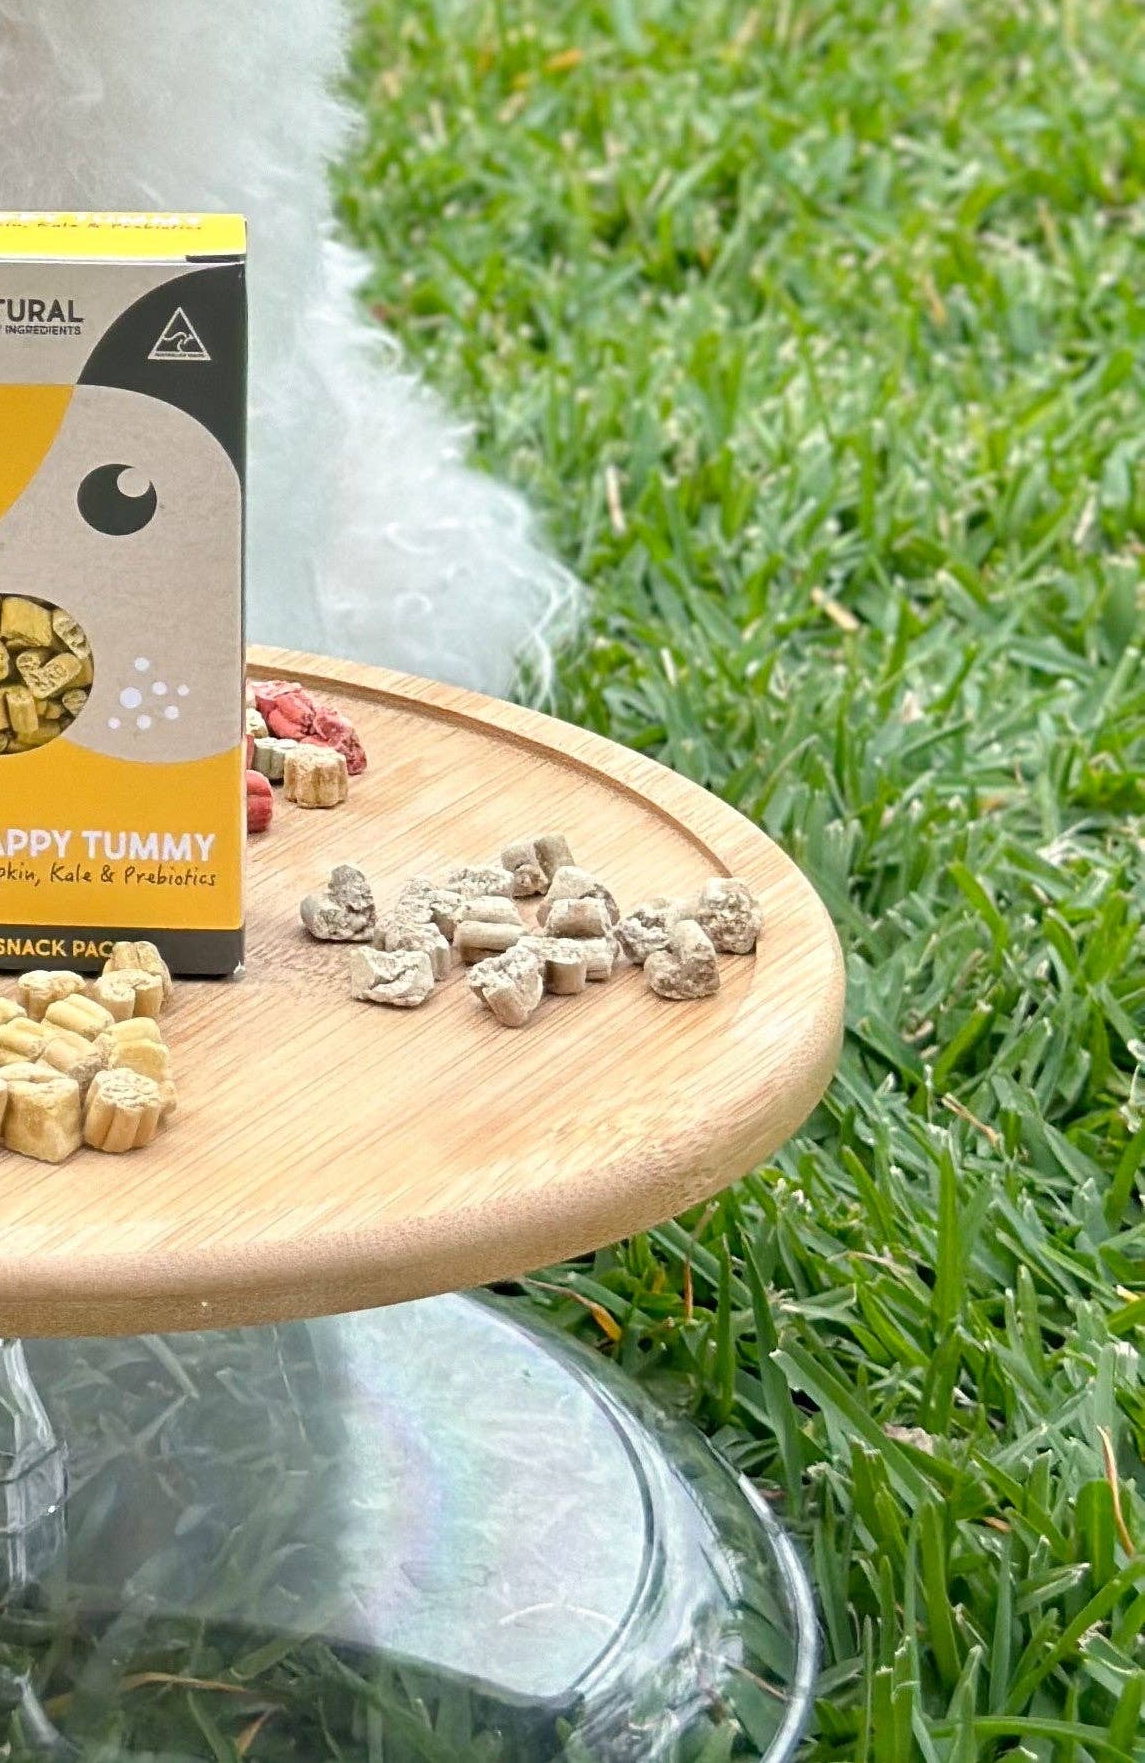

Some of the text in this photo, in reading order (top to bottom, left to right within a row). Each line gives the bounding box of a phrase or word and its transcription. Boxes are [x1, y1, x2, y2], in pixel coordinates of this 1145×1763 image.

[4, 325, 82, 336] INGREDIENTS
[81, 830, 216, 862] TUMMY
[49, 861, 93, 883] Kale
[100, 864, 115, 883] &
[123, 863, 217, 887] Prebiotics
[72, 940, 115, 958] PAC
